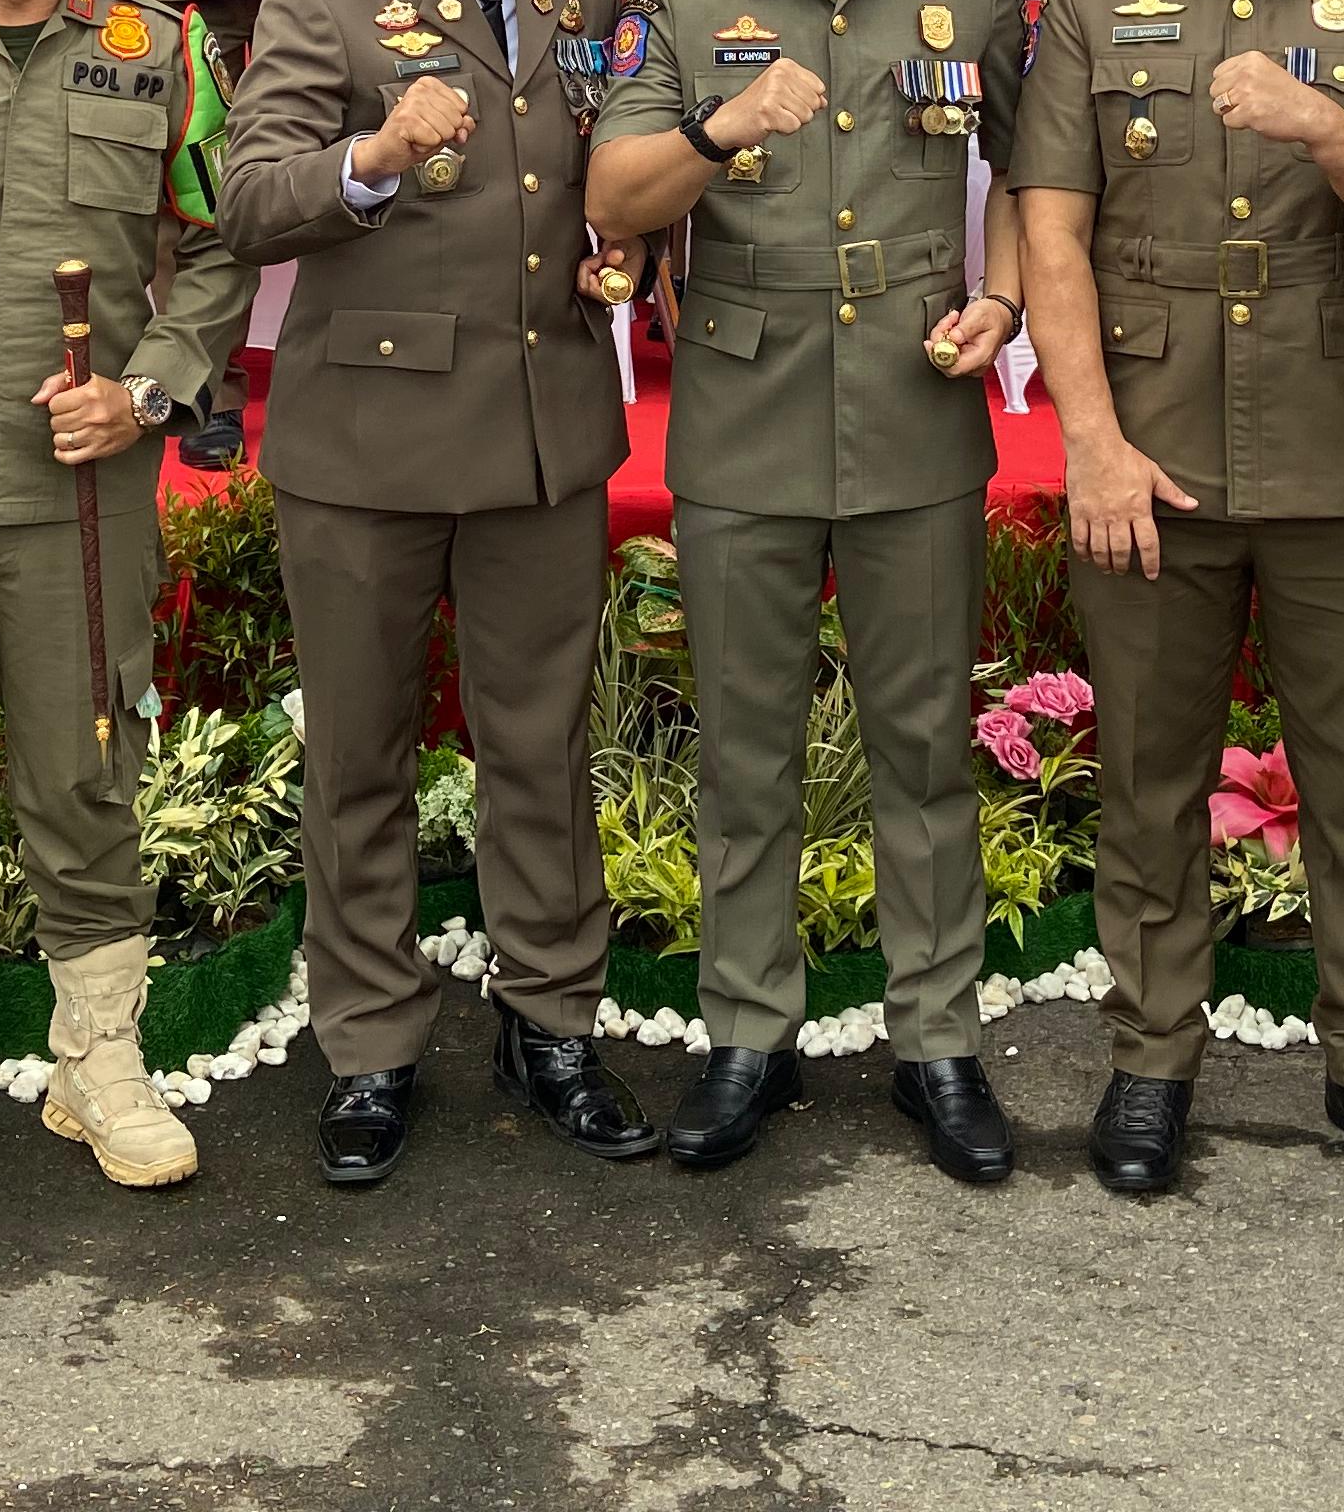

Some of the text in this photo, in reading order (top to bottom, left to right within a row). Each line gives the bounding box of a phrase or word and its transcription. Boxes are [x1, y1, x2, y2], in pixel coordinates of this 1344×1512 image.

[723, 52, 737, 62] ERI
[419, 60, 440, 69] OCTO
[72, 61, 164, 99] POL PP
